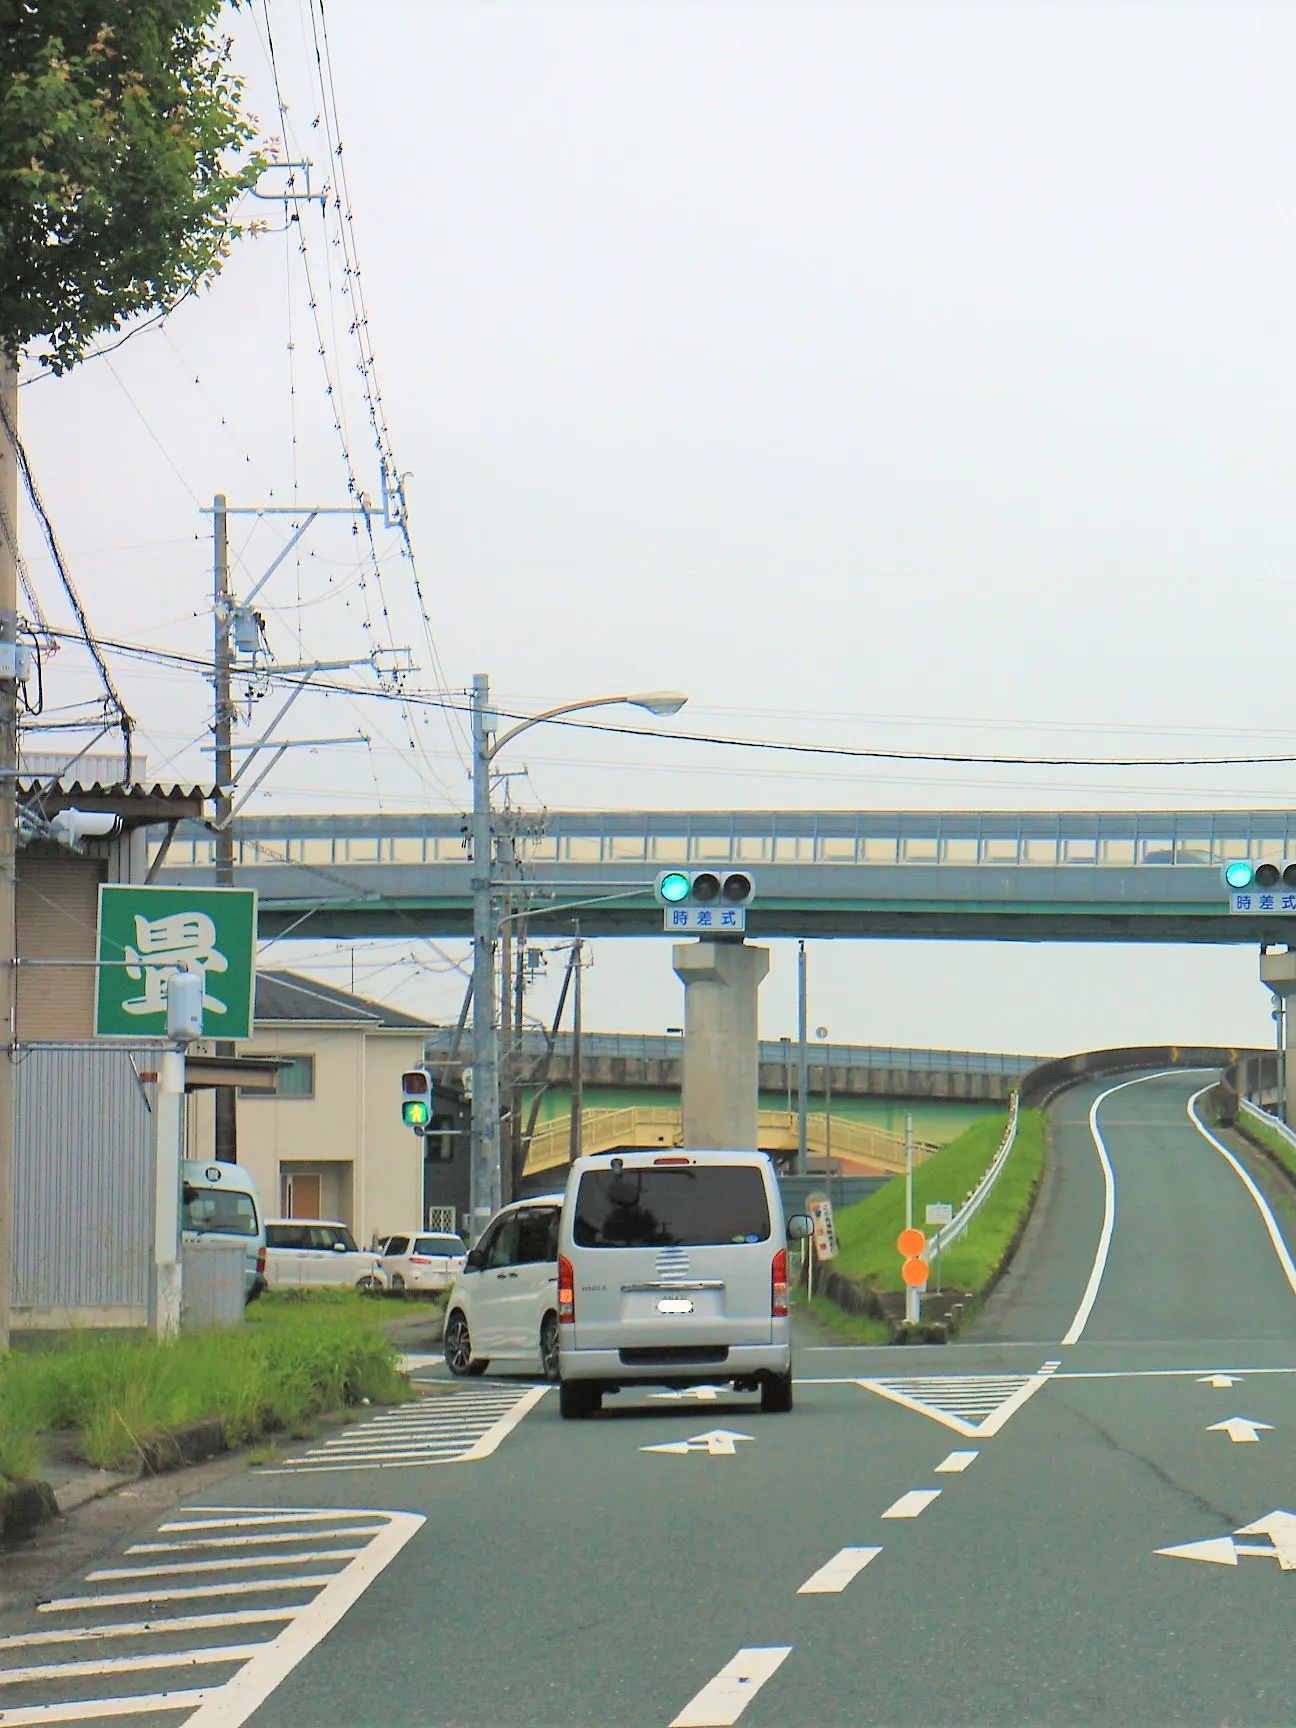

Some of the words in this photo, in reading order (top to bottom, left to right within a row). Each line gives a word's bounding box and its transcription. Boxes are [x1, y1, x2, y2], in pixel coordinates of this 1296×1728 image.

[1236, 895, 1296, 910] 時差式
[672, 911, 736, 926] 時差式
[121, 912, 229, 1015] 畳
